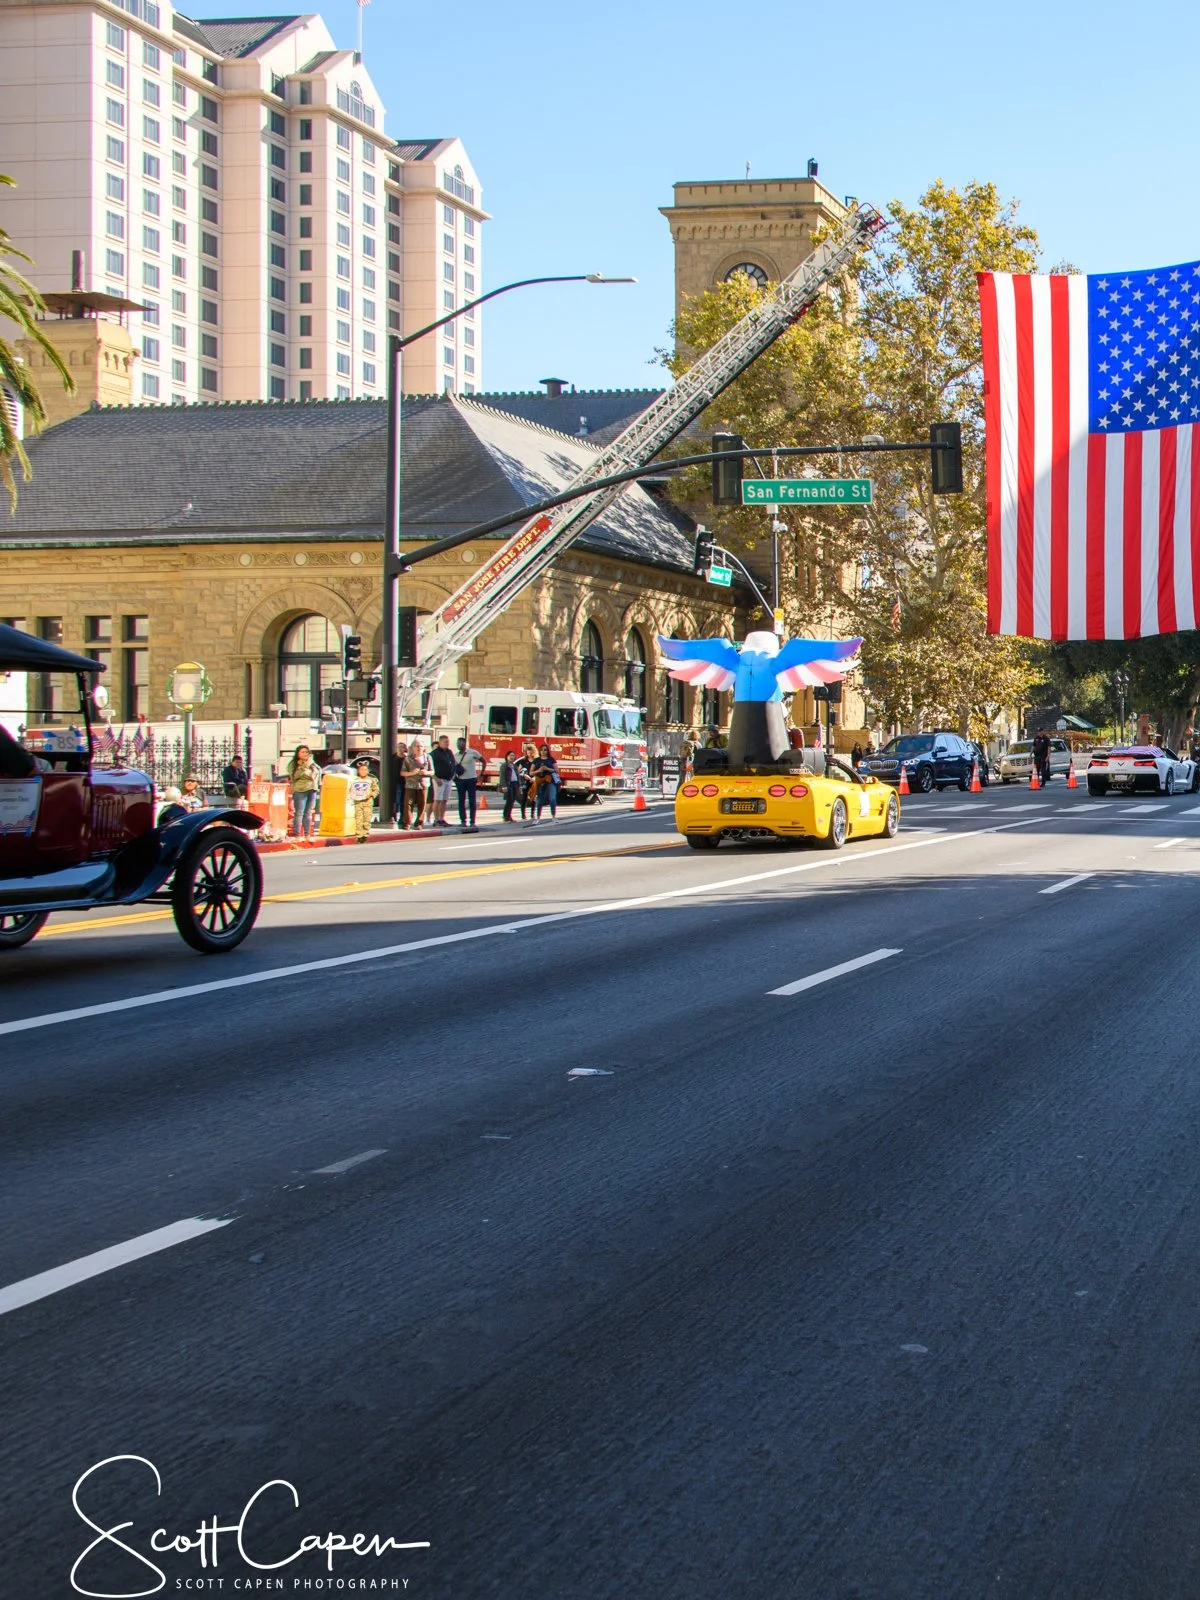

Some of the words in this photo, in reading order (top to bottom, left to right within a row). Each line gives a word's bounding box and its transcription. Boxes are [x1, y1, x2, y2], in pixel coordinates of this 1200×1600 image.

[747, 486, 773, 498] San
[779, 485, 845, 498] Fernando
[851, 484, 867, 497] St
[453, 591, 473, 611] SAN
[473, 570, 495, 592] JOSE
[493, 550, 516, 572] FIRE
[515, 527, 541, 552] DEPT.
